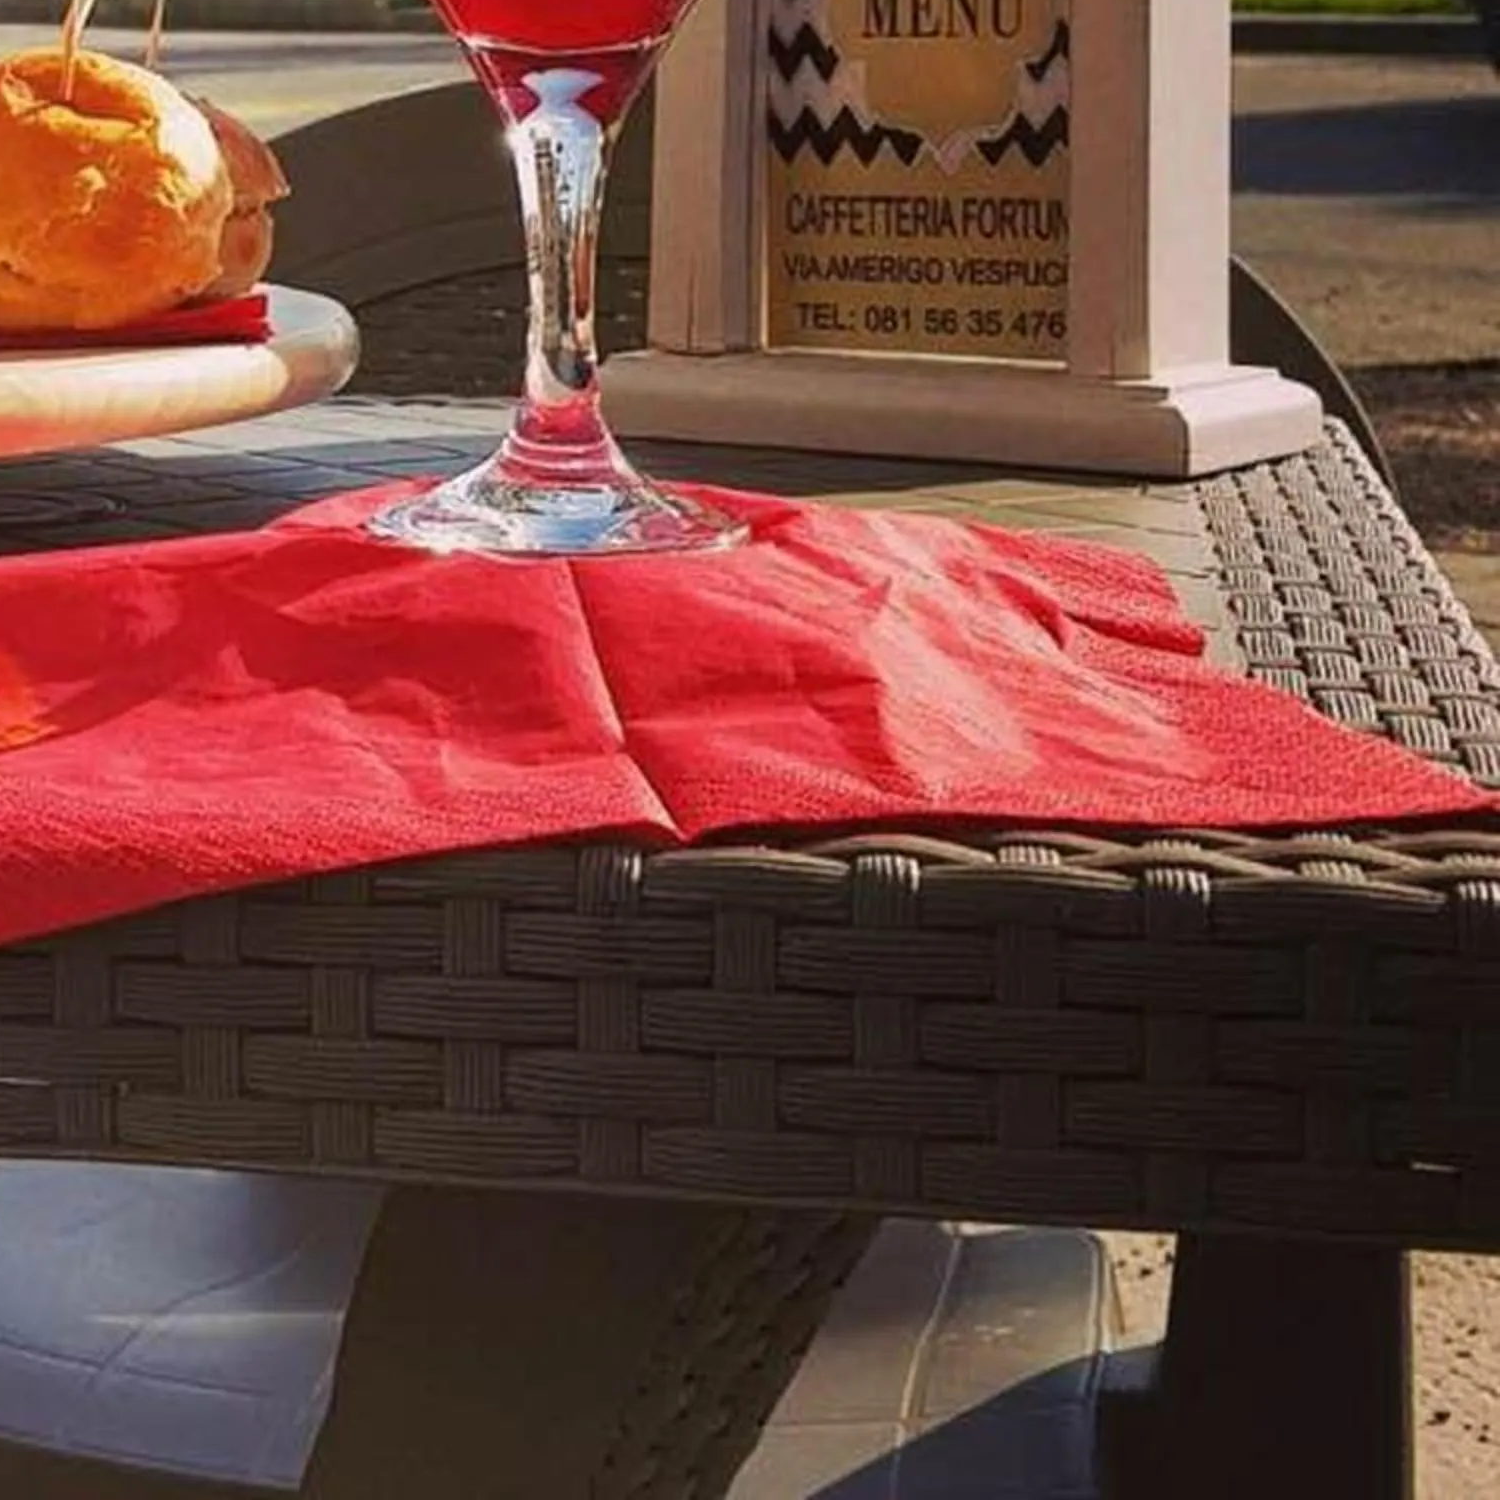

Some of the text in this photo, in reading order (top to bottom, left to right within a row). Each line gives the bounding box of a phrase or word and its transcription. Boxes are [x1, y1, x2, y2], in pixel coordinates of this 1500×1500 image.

[785, 195, 956, 238] CAFFETTERIA
[798, 303, 1067, 340] TEL: 081 56 35 476
